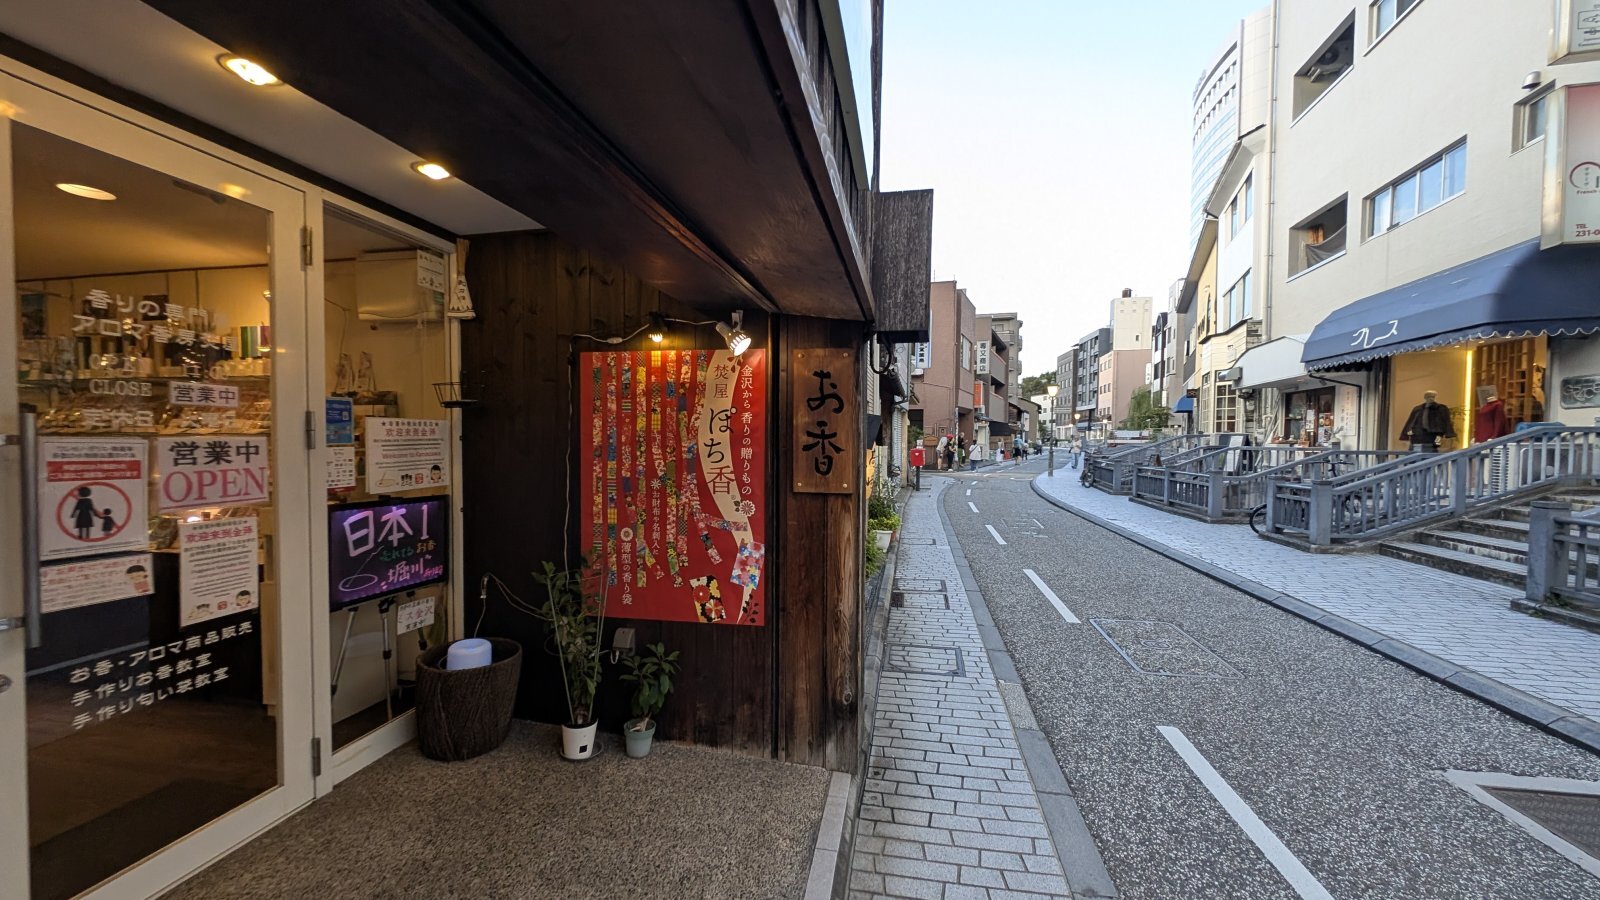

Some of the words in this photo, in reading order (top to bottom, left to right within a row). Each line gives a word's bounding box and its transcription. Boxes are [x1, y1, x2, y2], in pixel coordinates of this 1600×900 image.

[85, 288, 222, 326] 香りの専門
[89, 378, 153, 397] CLOSE
[173, 384, 236, 404] 営業中
[741, 364, 753, 496] 金沢から香りの贈りもの
[802, 369, 845, 477] お香
[168, 440, 261, 467] 営業中
[703, 406, 736, 495] ぽち香
[163, 466, 268, 503] OPEN
[69, 620, 253, 684] お香・アロマ商品販売
[71, 652, 214, 708] 手作りお香教室
